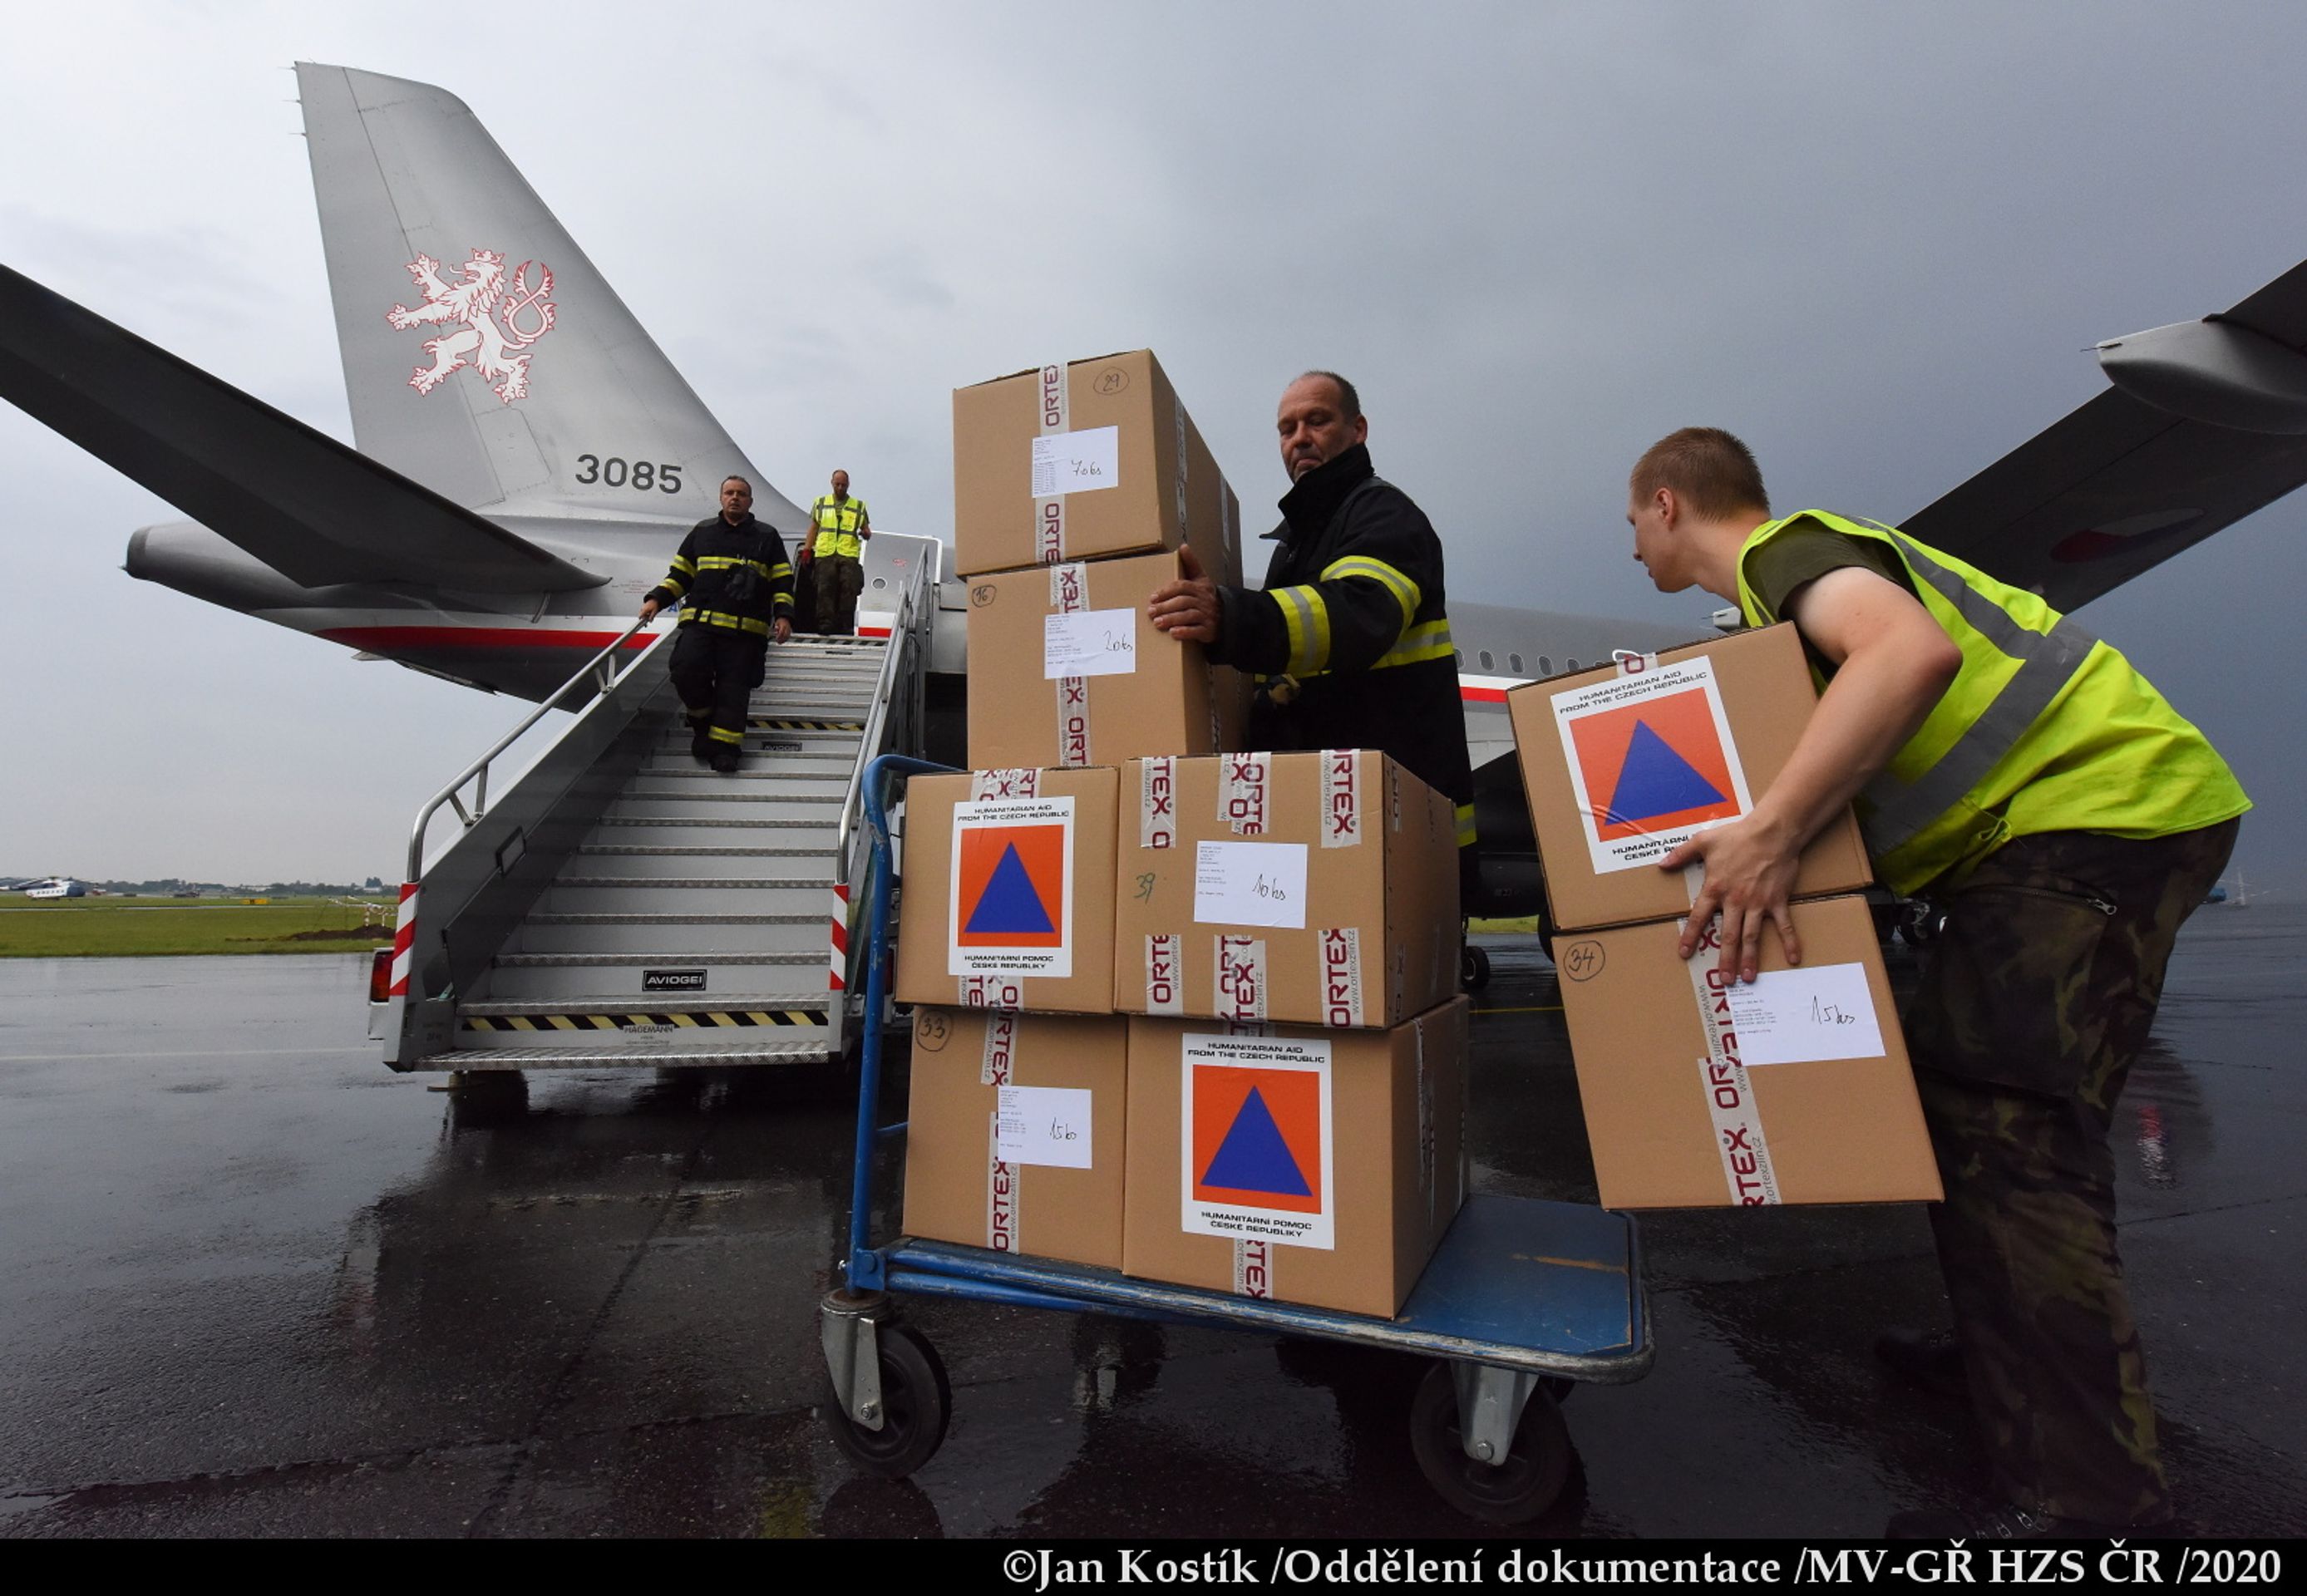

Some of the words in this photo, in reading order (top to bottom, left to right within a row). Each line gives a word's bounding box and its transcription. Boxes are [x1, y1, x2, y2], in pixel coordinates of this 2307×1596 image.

[1102, 373, 1120, 392] 29
[575, 454, 682, 494] 3085
[1560, 702, 1590, 714] FROM
[1593, 697, 1613, 707] THE
[1615, 687, 1651, 700] CZECH
[1654, 672, 1707, 691] REPUBLIC
[1579, 677, 1659, 702] HUMANITARIAN
[1663, 671, 1681, 680] AID
[1333, 749, 1354, 835] RTEX
[974, 805, 1035, 814] HUMANITARIAN
[1569, 947, 1595, 972] 34
[647, 976, 702, 984] AVIOGEI
[1325, 929, 1351, 1027] ORTEX
[991, 1011, 1013, 1086] RTEX
[1208, 1042, 1283, 1053] HUMANITARIAN
[1285, 1046, 1304, 1054] AID
[1240, 1052, 1273, 1061] CZECH
[1275, 1053, 1325, 1064] REPUBLIC
[1246, 1225, 1304, 1238] REPUBLIKY
[1273, 1219, 1313, 1230] POMOC
